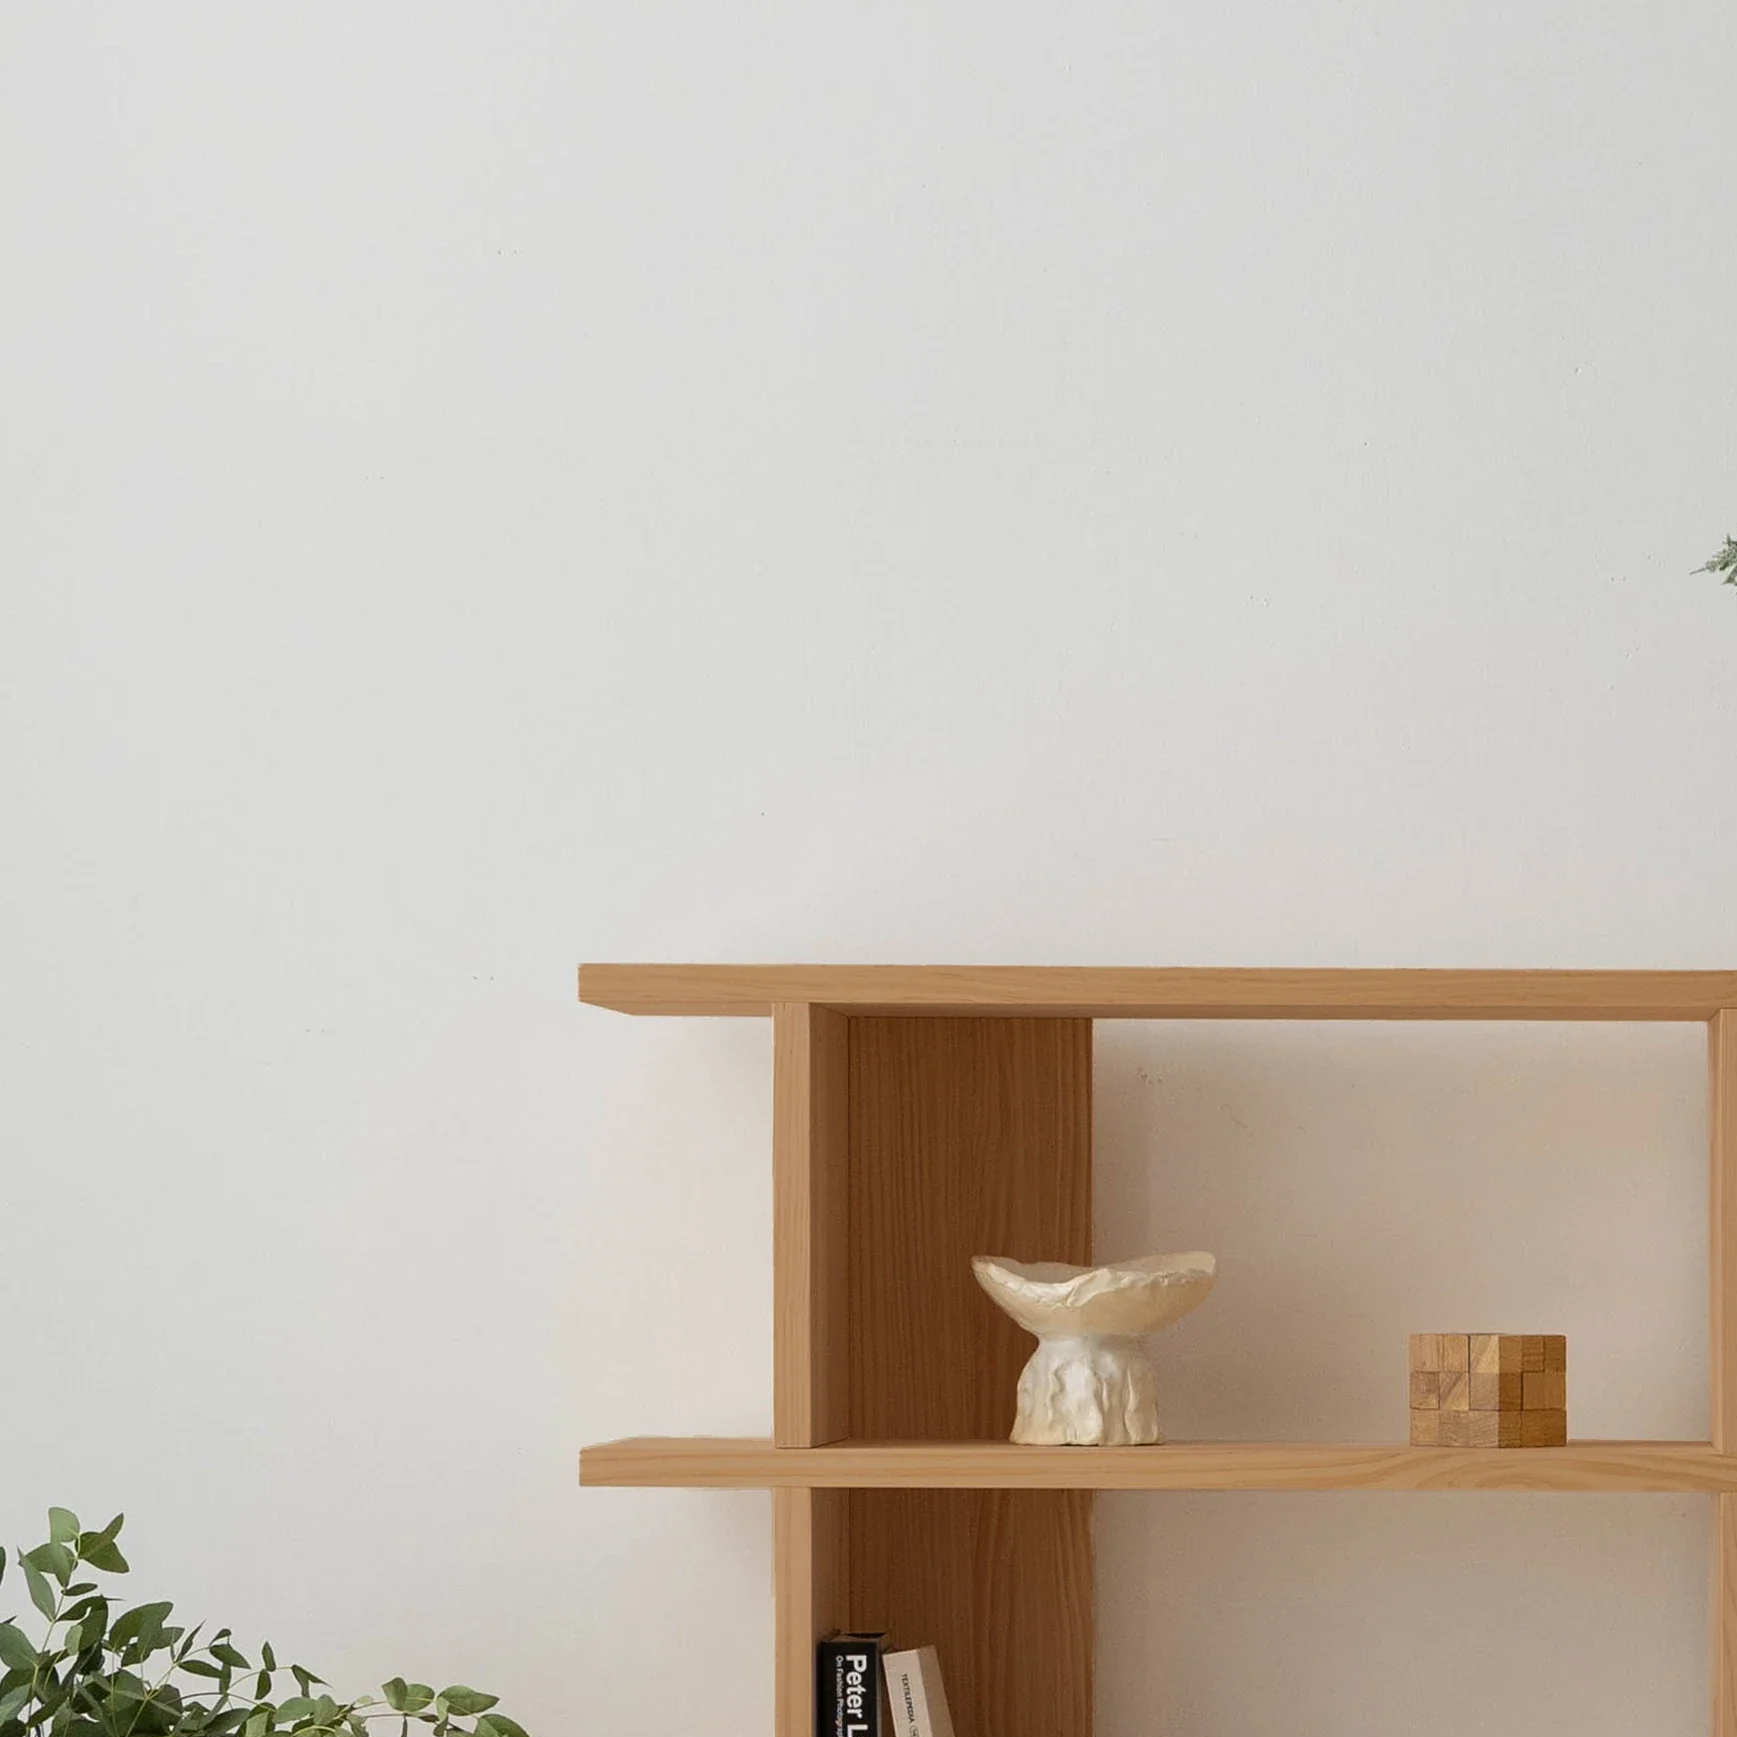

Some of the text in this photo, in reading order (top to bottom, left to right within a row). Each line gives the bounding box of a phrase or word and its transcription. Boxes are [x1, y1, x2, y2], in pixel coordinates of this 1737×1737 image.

[835, 1655, 844, 1668] On
[836, 1668, 845, 1698] Fashion
[845, 1654, 867, 1719] Peter
[901, 1673, 915, 1723] TEXTILEPEDIA
